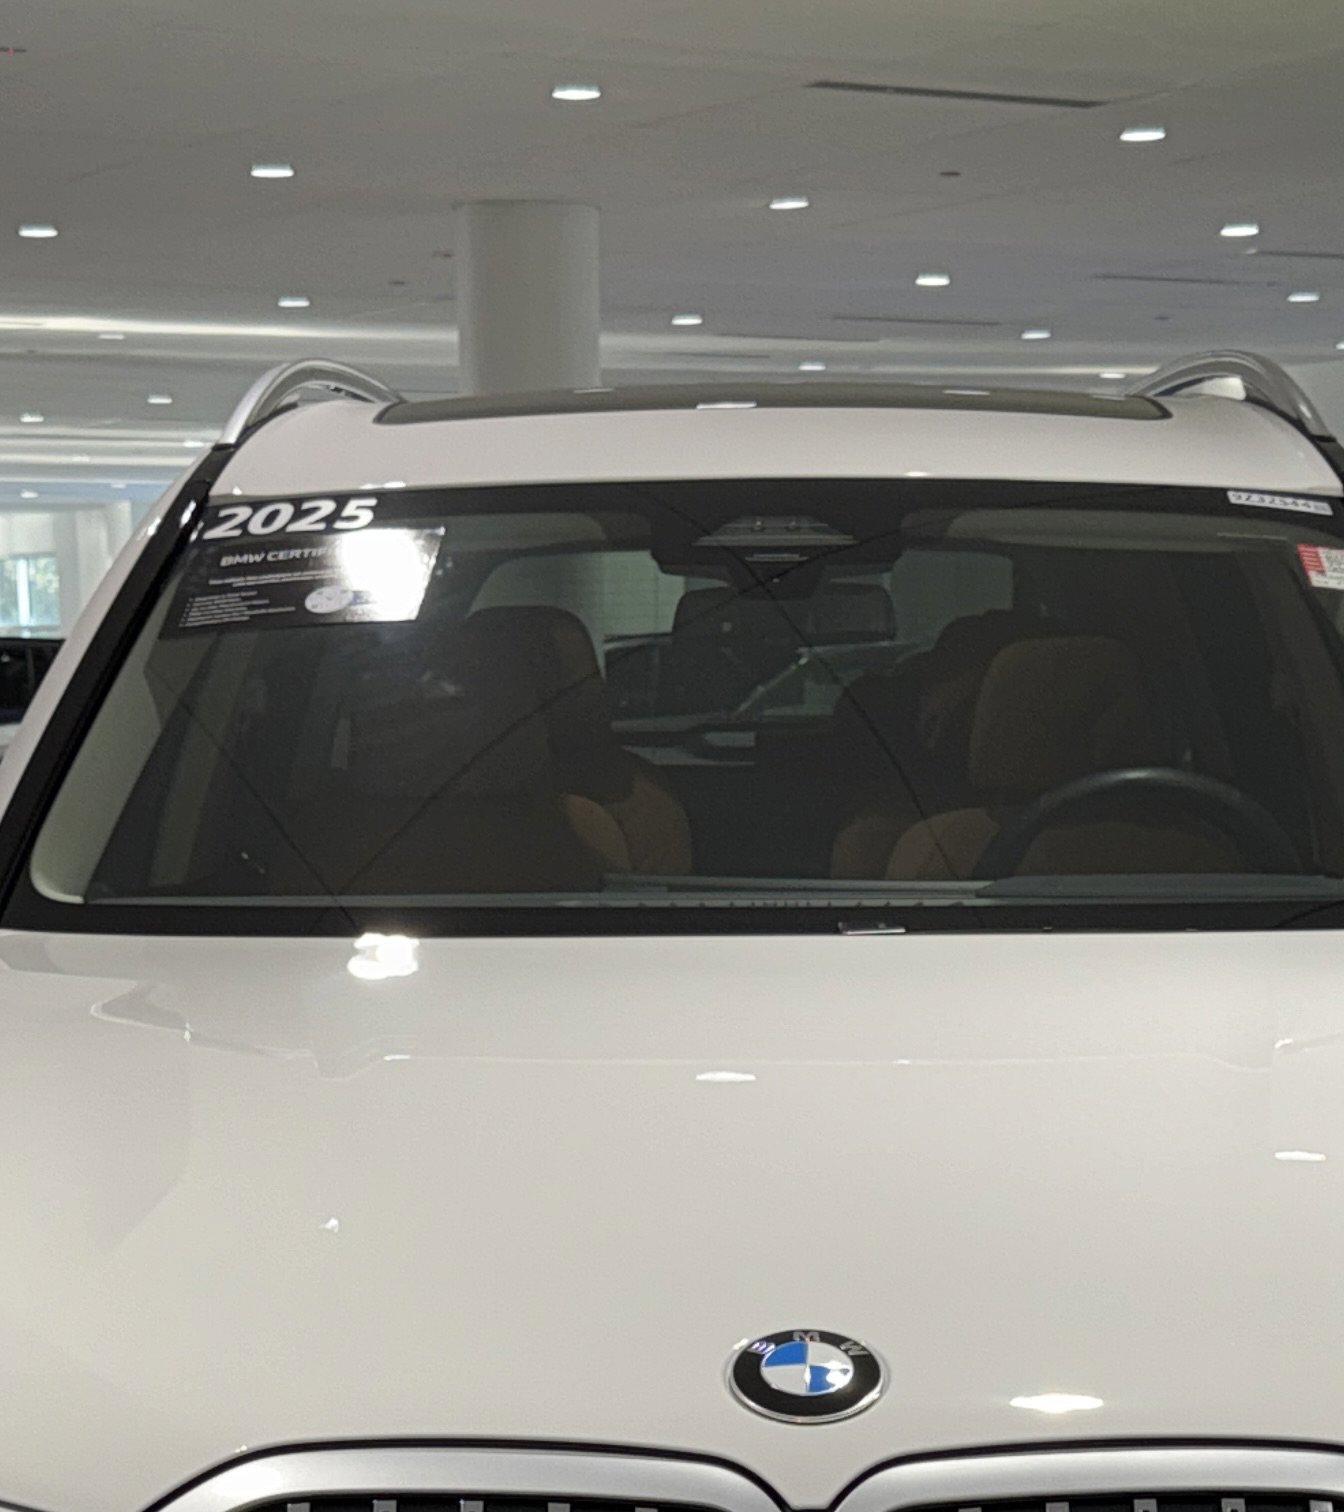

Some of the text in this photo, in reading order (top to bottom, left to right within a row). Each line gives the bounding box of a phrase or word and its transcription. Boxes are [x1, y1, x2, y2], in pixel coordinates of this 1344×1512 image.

[203, 497, 378, 540] 2025
[219, 546, 338, 567] BMW CERTIF
[748, 1331, 869, 1356] BMW
